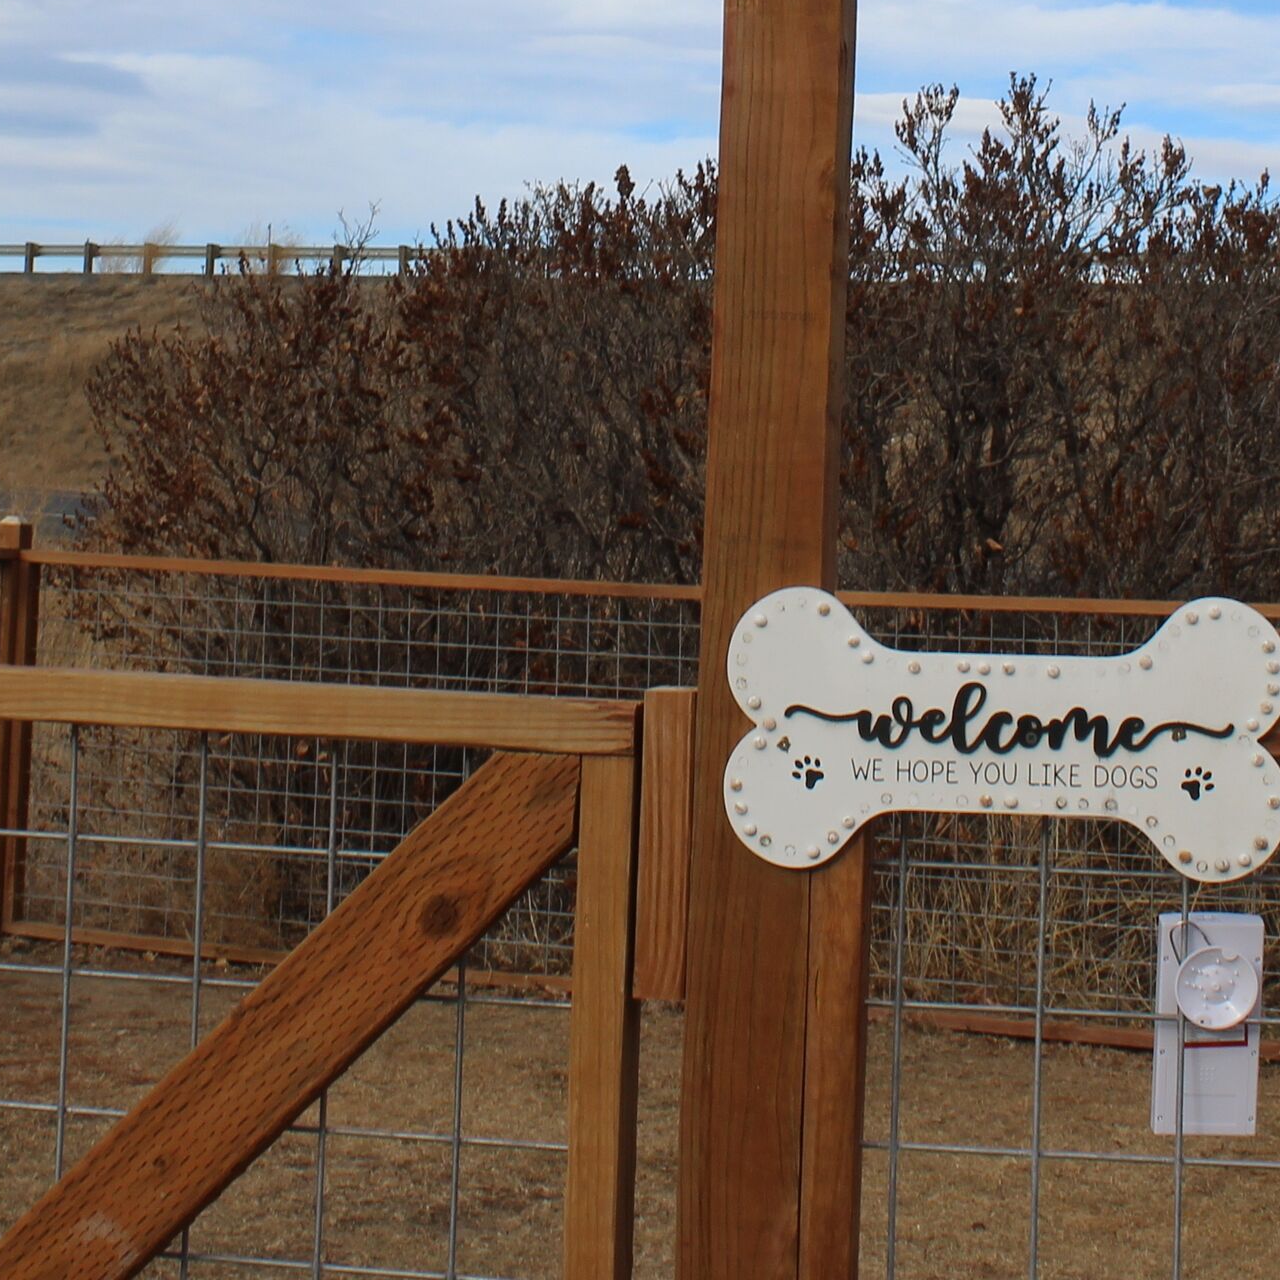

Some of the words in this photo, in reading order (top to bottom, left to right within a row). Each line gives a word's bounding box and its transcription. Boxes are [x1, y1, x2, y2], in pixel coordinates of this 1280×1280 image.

[784, 681, 1235, 758] welcome
[851, 757, 885, 783] WE
[896, 759, 958, 785] HOPE
[969, 761, 1018, 786] YOU
[1028, 763, 1082, 788] LIKE
[1094, 764, 1158, 790] DOGS
